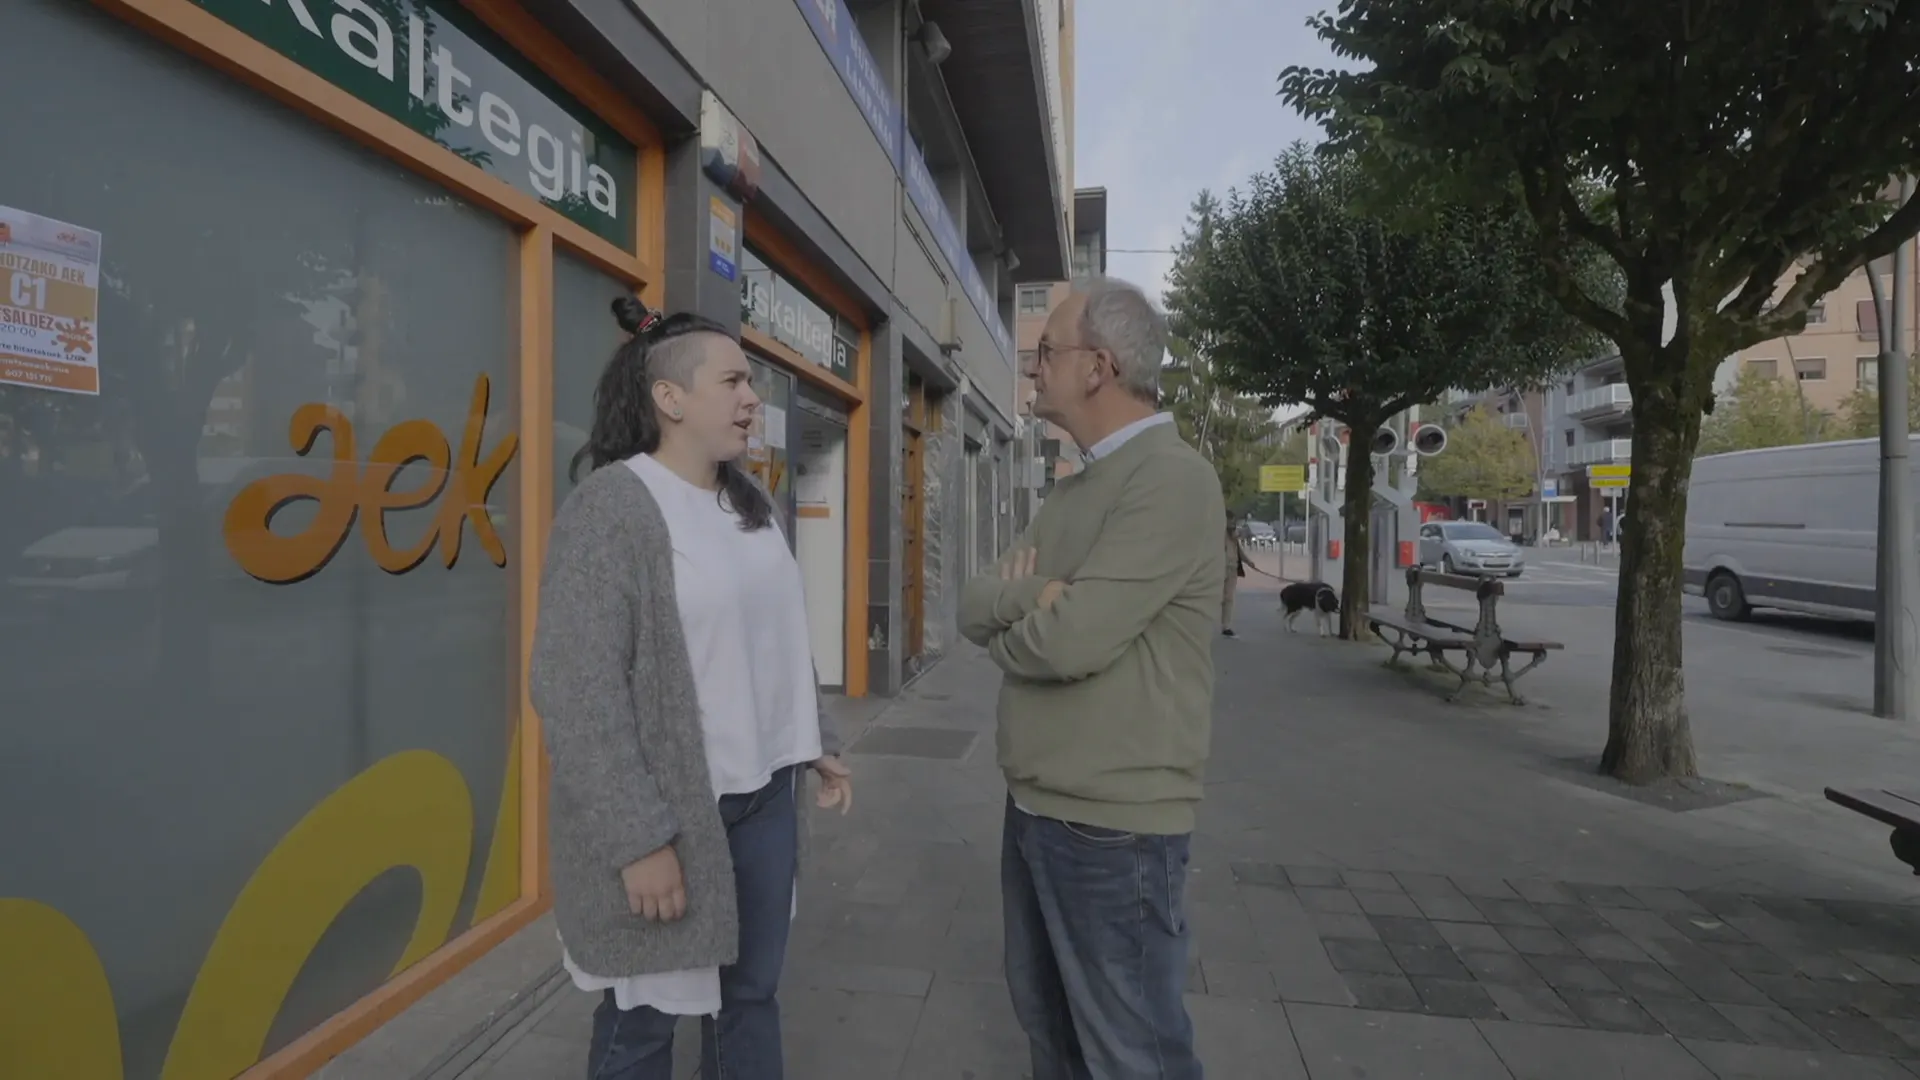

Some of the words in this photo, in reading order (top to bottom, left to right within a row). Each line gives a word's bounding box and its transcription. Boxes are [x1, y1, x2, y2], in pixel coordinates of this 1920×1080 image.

[10, 272, 46, 310] C1
[61, 267, 85, 284] AEK
[0, 307, 54, 331] SALDEZ
[223, 371, 519, 585] aek
